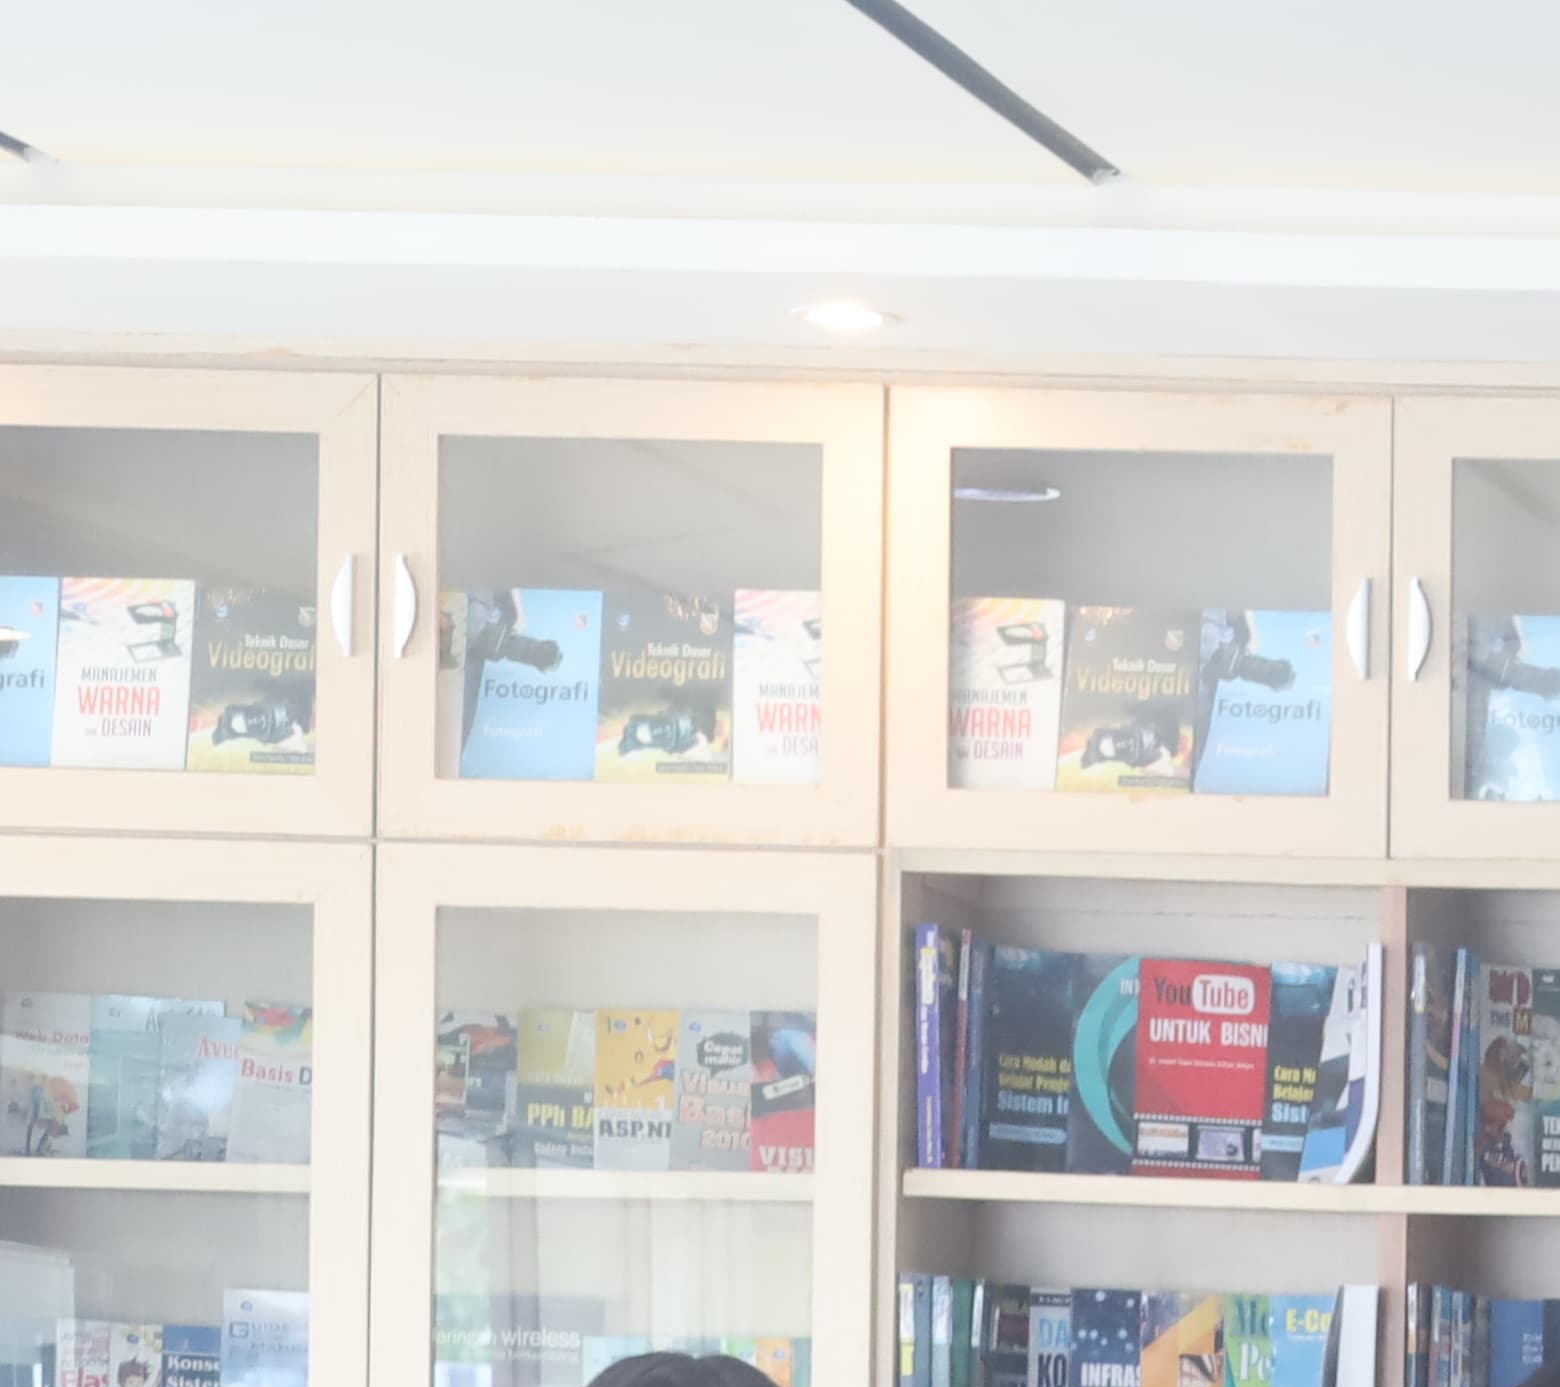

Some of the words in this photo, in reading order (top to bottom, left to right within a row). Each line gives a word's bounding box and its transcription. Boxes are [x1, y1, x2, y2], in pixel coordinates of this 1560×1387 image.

[81, 666, 158, 683] MANAJEMEN
[610, 650, 727, 687] Videografi
[483, 677, 590, 705] Fotografi
[1075, 665, 1192, 700] Videografi
[77, 686, 161, 716] WARNA
[1216, 697, 1323, 724] Fotografi
[101, 718, 152, 737] DESAIN
[1149, 1018, 1212, 1045] UNTUK
[240, 1058, 293, 1084] Basis
[501, 1326, 581, 1349] wireless
